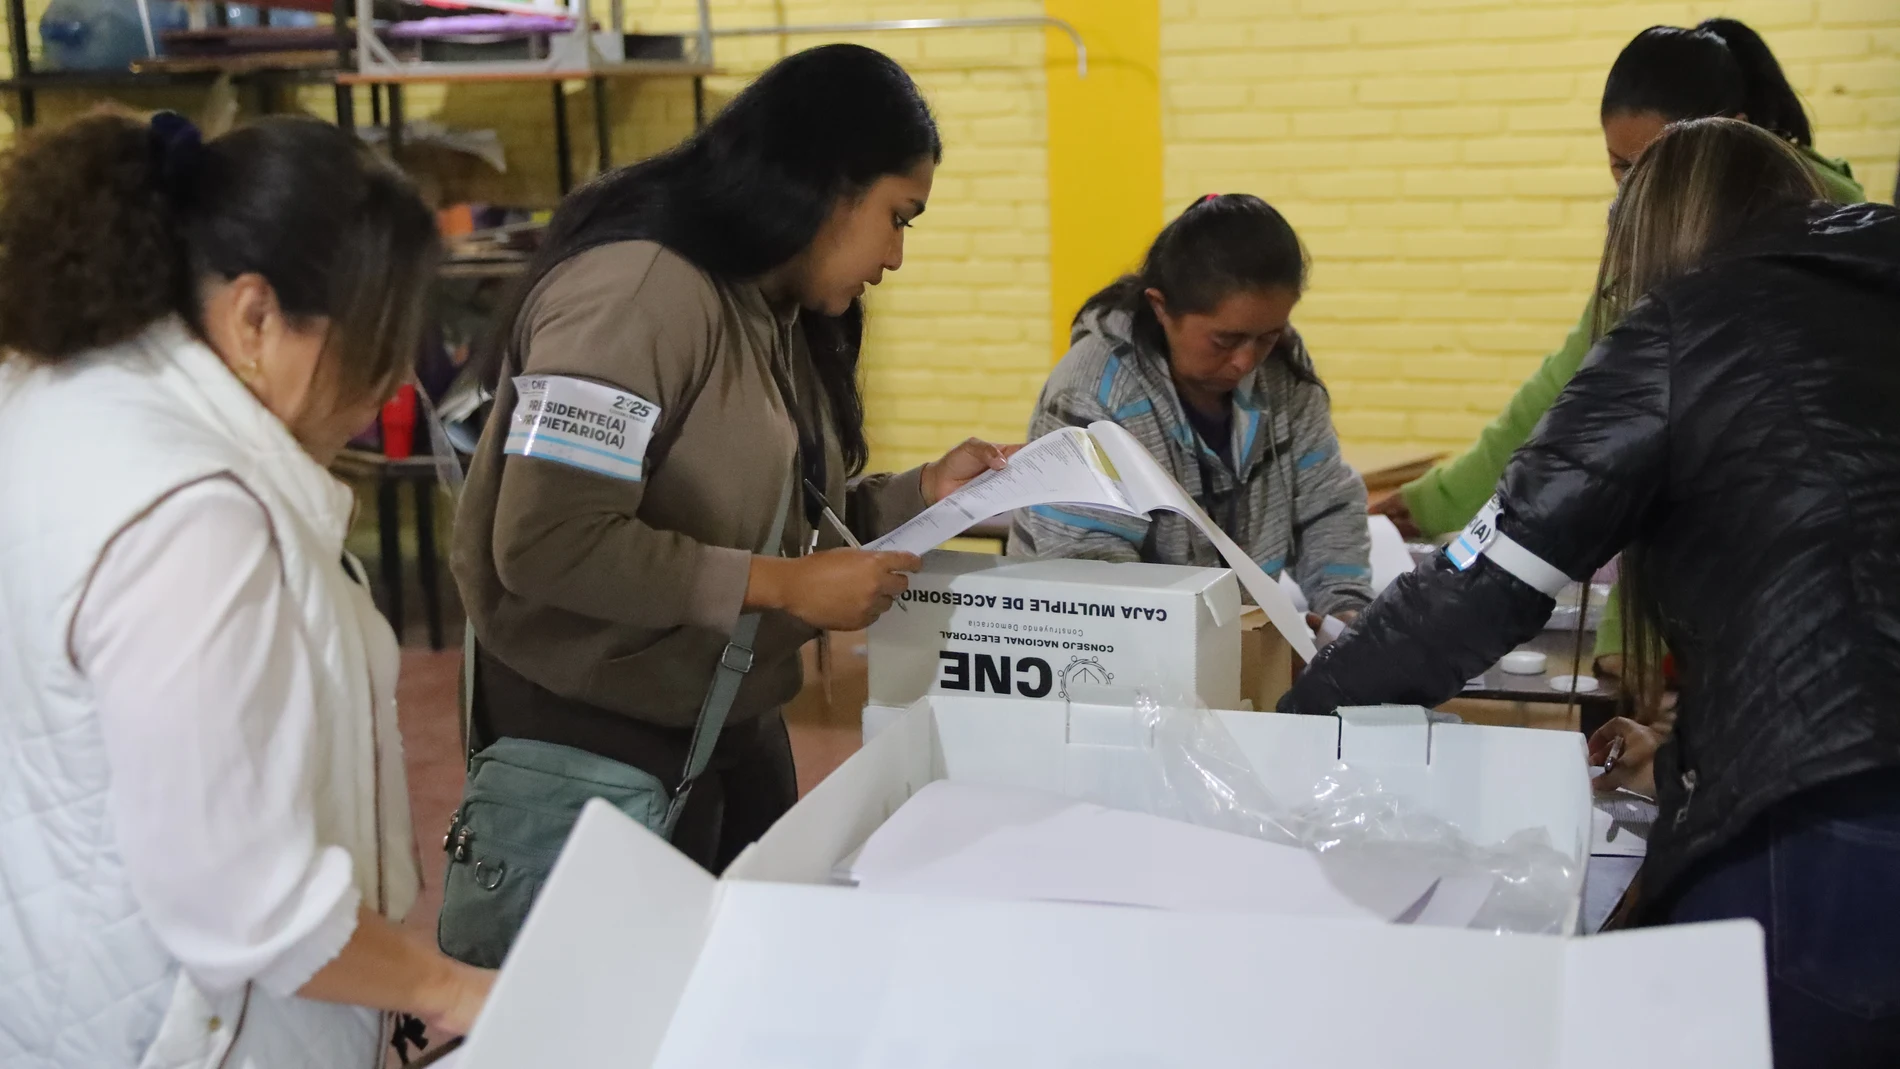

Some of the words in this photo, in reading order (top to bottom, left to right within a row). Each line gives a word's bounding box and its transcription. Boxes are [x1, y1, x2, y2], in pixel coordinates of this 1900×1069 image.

[528, 399, 627, 434] PRESIDENTE(A)
[1002, 596, 1024, 611] DE
[1029, 598, 1115, 617] MULTIPLE
[1121, 605, 1167, 622] CAJA
[968, 619, 1019, 632] Democracia
[1022, 623, 1084, 637] Construyendo
[939, 630, 1000, 644] ELECTORAL
[1003, 636, 1059, 649] NACIONAL
[1062, 641, 1114, 653] CONSEJO
[939, 650, 1053, 699] CNE
